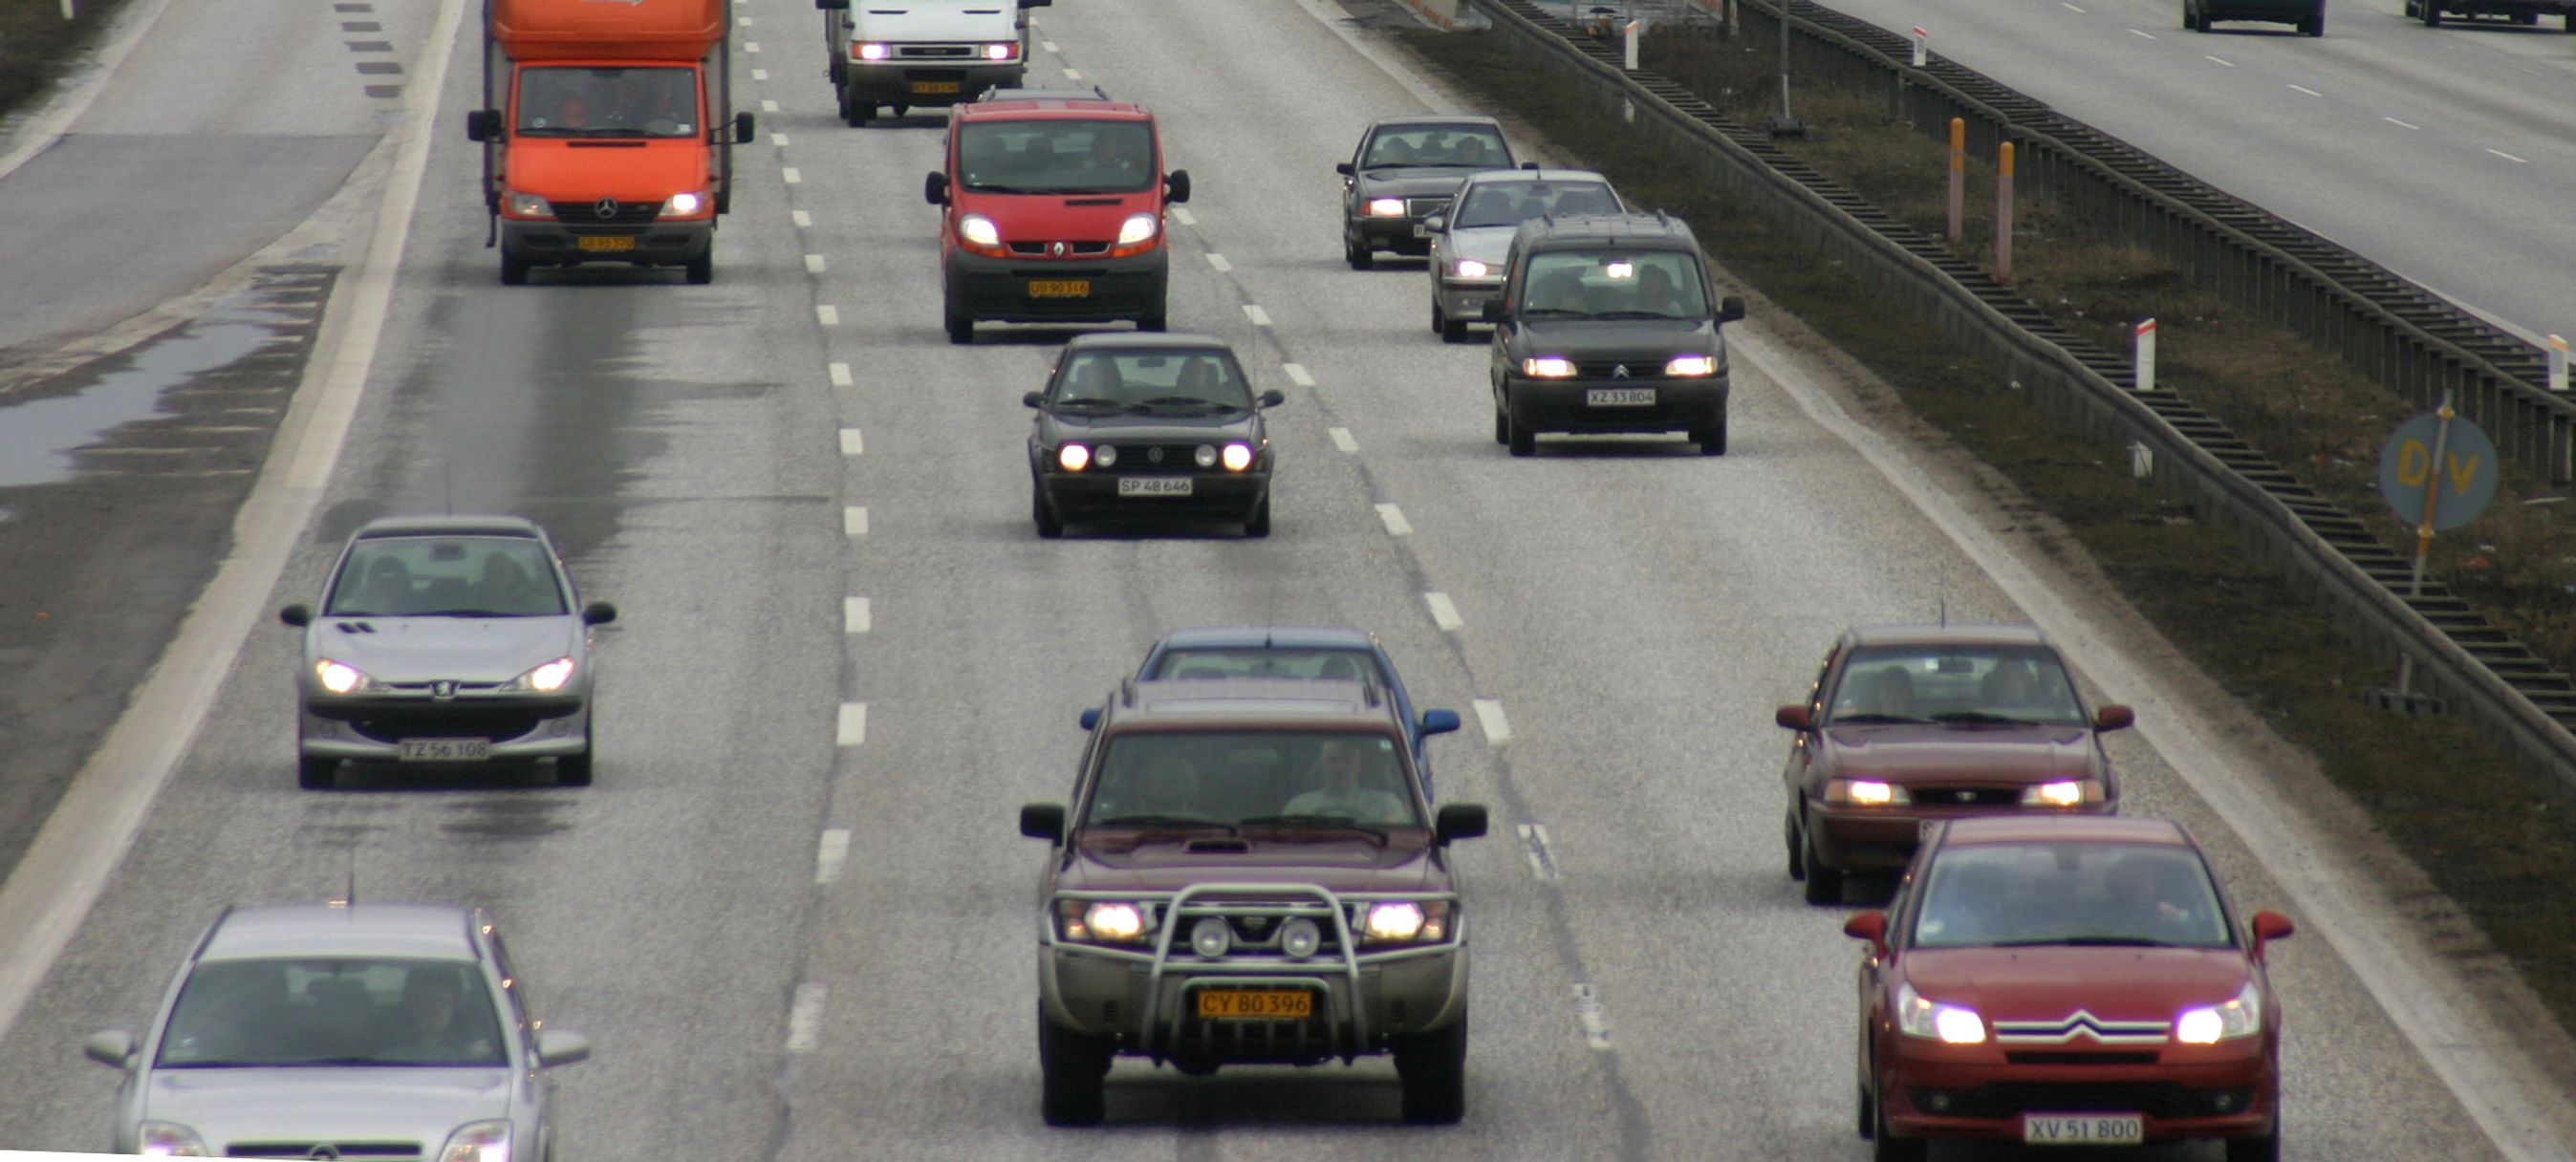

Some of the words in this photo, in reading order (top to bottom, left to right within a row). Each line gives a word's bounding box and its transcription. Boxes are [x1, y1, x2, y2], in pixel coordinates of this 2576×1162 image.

[1591, 392, 1608, 403] XZ
[1629, 391, 1654, 402] 804
[1121, 480, 1141, 492] SP
[1144, 480, 1161, 492] 48
[1163, 480, 1190, 492] 646
[403, 742, 426, 757] TZ
[430, 742, 452, 756] 56
[458, 742, 488, 757] 108
[1203, 995, 1232, 1013] CY
[1239, 995, 1264, 1013] 80
[1268, 995, 1307, 1013] 396
[2031, 1120, 2061, 1138] XV
[2067, 1120, 2089, 1138] 51
[2098, 1120, 2138, 1138] 800
